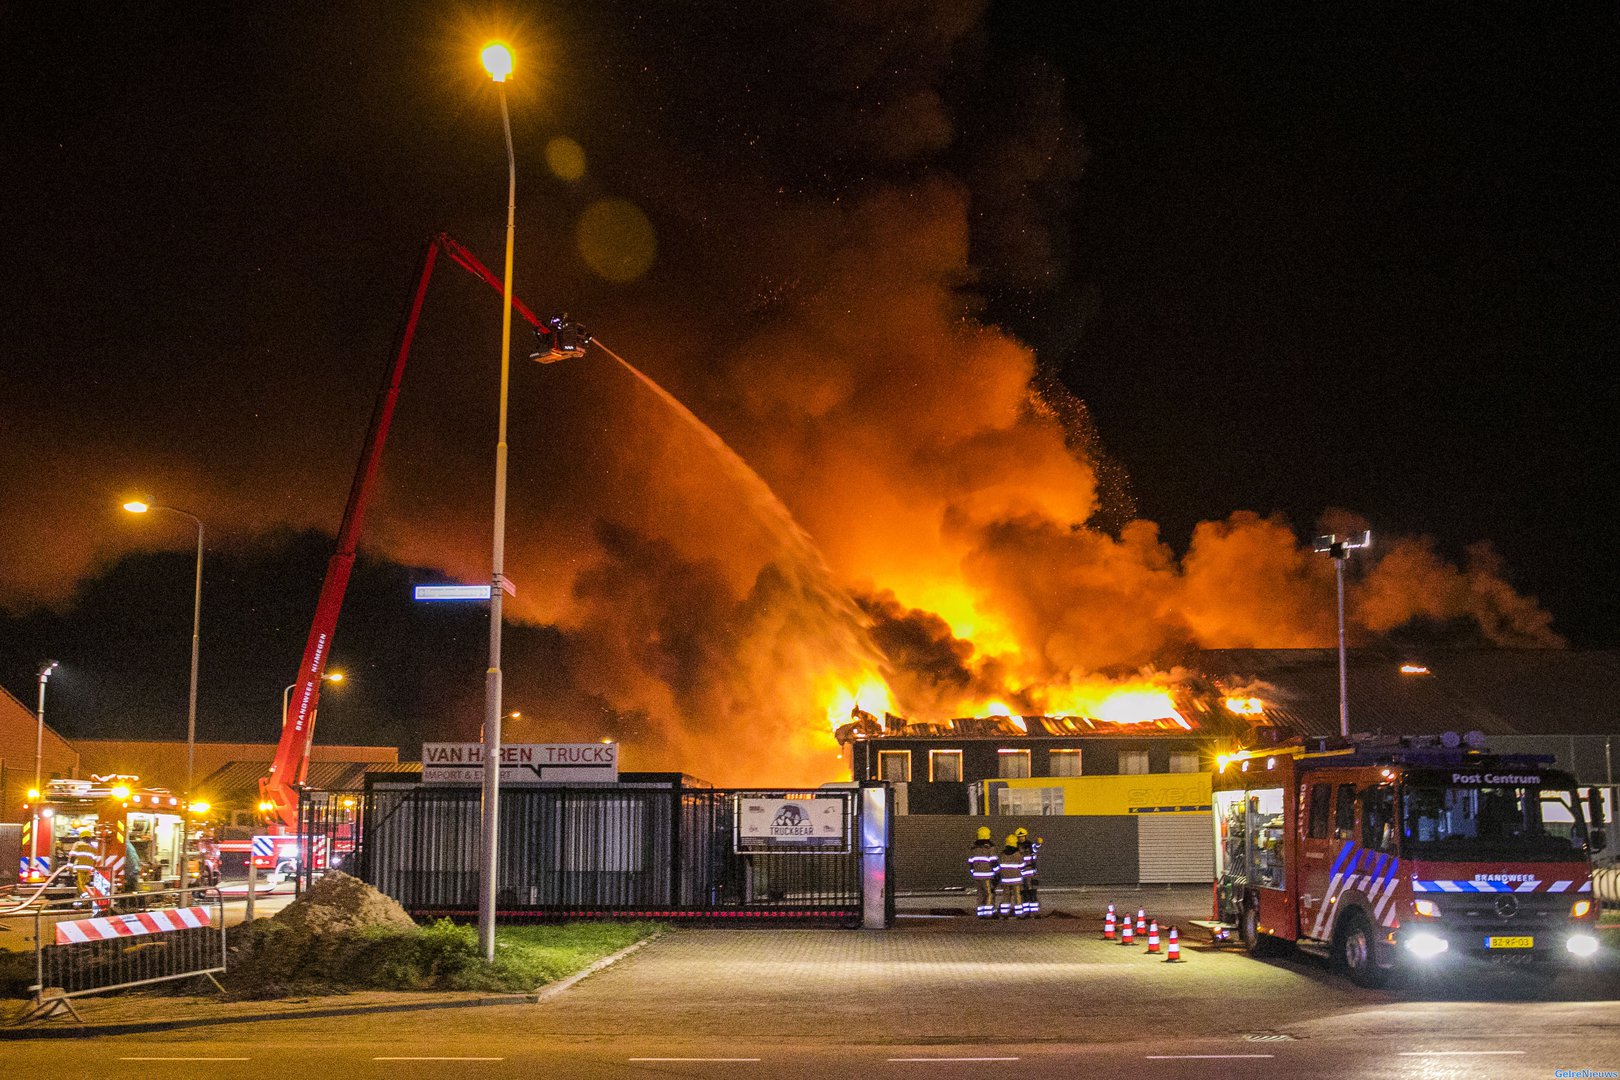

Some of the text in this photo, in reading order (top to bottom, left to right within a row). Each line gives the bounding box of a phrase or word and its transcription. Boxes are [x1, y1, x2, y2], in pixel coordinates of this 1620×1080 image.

[295, 633, 326, 731] BRANDWEER NIJMEGEN
[427, 747, 613, 762] VAN HREN TRUCKS
[424, 770, 462, 780] IMPORT
[464, 770, 472, 780] &
[1452, 773, 1540, 784] Post Centrum
[770, 826, 814, 836] TRUCKBEAR
[1474, 874, 1535, 882] BRANDWEER
